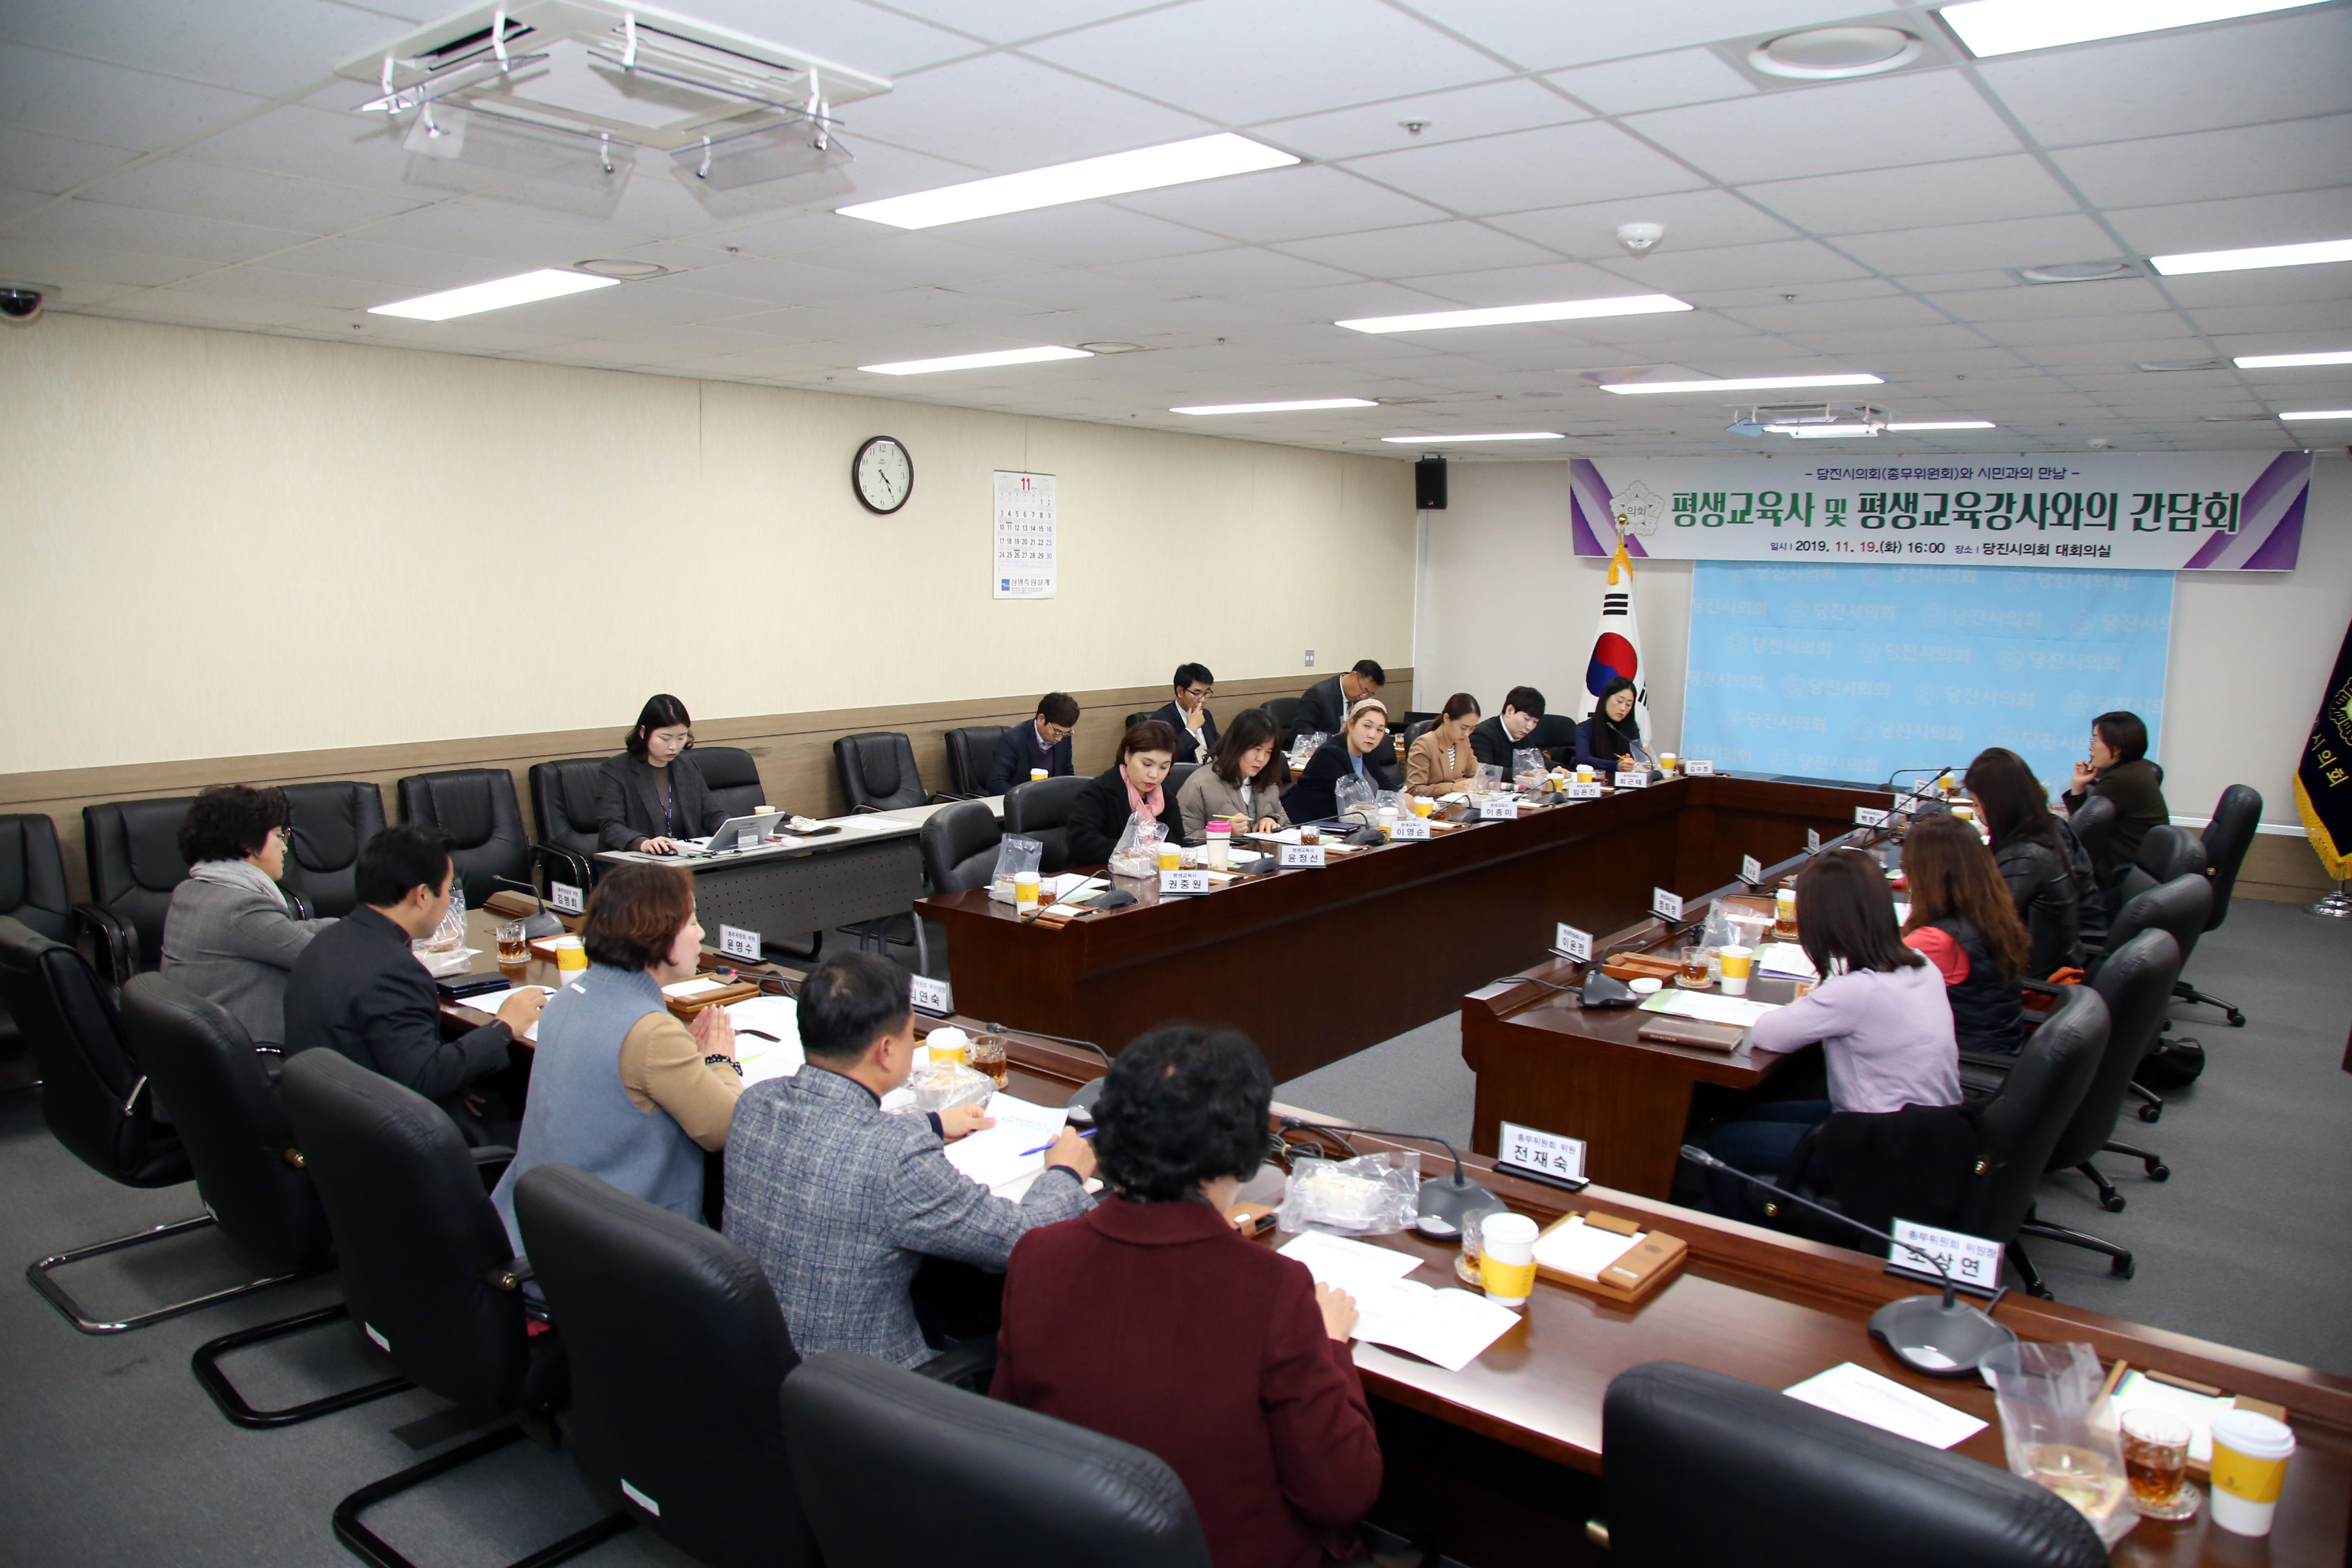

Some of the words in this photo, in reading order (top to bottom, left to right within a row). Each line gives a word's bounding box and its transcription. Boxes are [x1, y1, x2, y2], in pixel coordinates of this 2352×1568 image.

[1022, 477, 1030, 491] 11
[1978, 467, 2034, 480] 시민과의
[2038, 467, 2066, 480] 만남
[1627, 506, 1646, 517] 의회
[1671, 491, 1815, 528] 평생교육사
[1825, 498, 1847, 527] 및
[1858, 491, 2119, 532] 평생교육강사와의
[2130, 491, 2240, 532] 간담회
[1770, 542, 1787, 551] 일시
[1795, 540, 1829, 552] 2019.
[1835, 542, 1855, 553] 11.
[1861, 541, 1902, 554] 19.(화)
[1908, 542, 1945, 553] 16:00
[1955, 545, 1973, 554] 장소
[1982, 543, 2049, 556] 당진시의회
[2055, 544, 2112, 557] 대회의실
[1814, 602, 1897, 622] 당진시의회
[1953, 607, 2042, 629] 당진시의회
[1752, 636, 1832, 657] 당진시의회
[1884, 642, 1972, 664] 당진시의회
[2029, 651, 2122, 672] 당진시의회
[1808, 678, 1891, 699] 당진시의회
[1946, 686, 2035, 708] 당진시의회
[1746, 711, 1827, 732] 당진시의회
[1879, 721, 1965, 743] 당진시의회
[1396, 828, 1424, 836] 이영순
[1288, 854, 1318, 862] 윤정선
[1169, 879, 1201, 889] 권중원
[728, 939, 753, 954] 윤명수
[1518, 1133, 1556, 1149] 총무위원회
[1561, 1143, 1576, 1155] 위원
[1514, 1145, 1569, 1173] 전재숙
[1908, 1230, 1960, 1250] 총무위원회
[1965, 1243, 1997, 1259] 위원장
